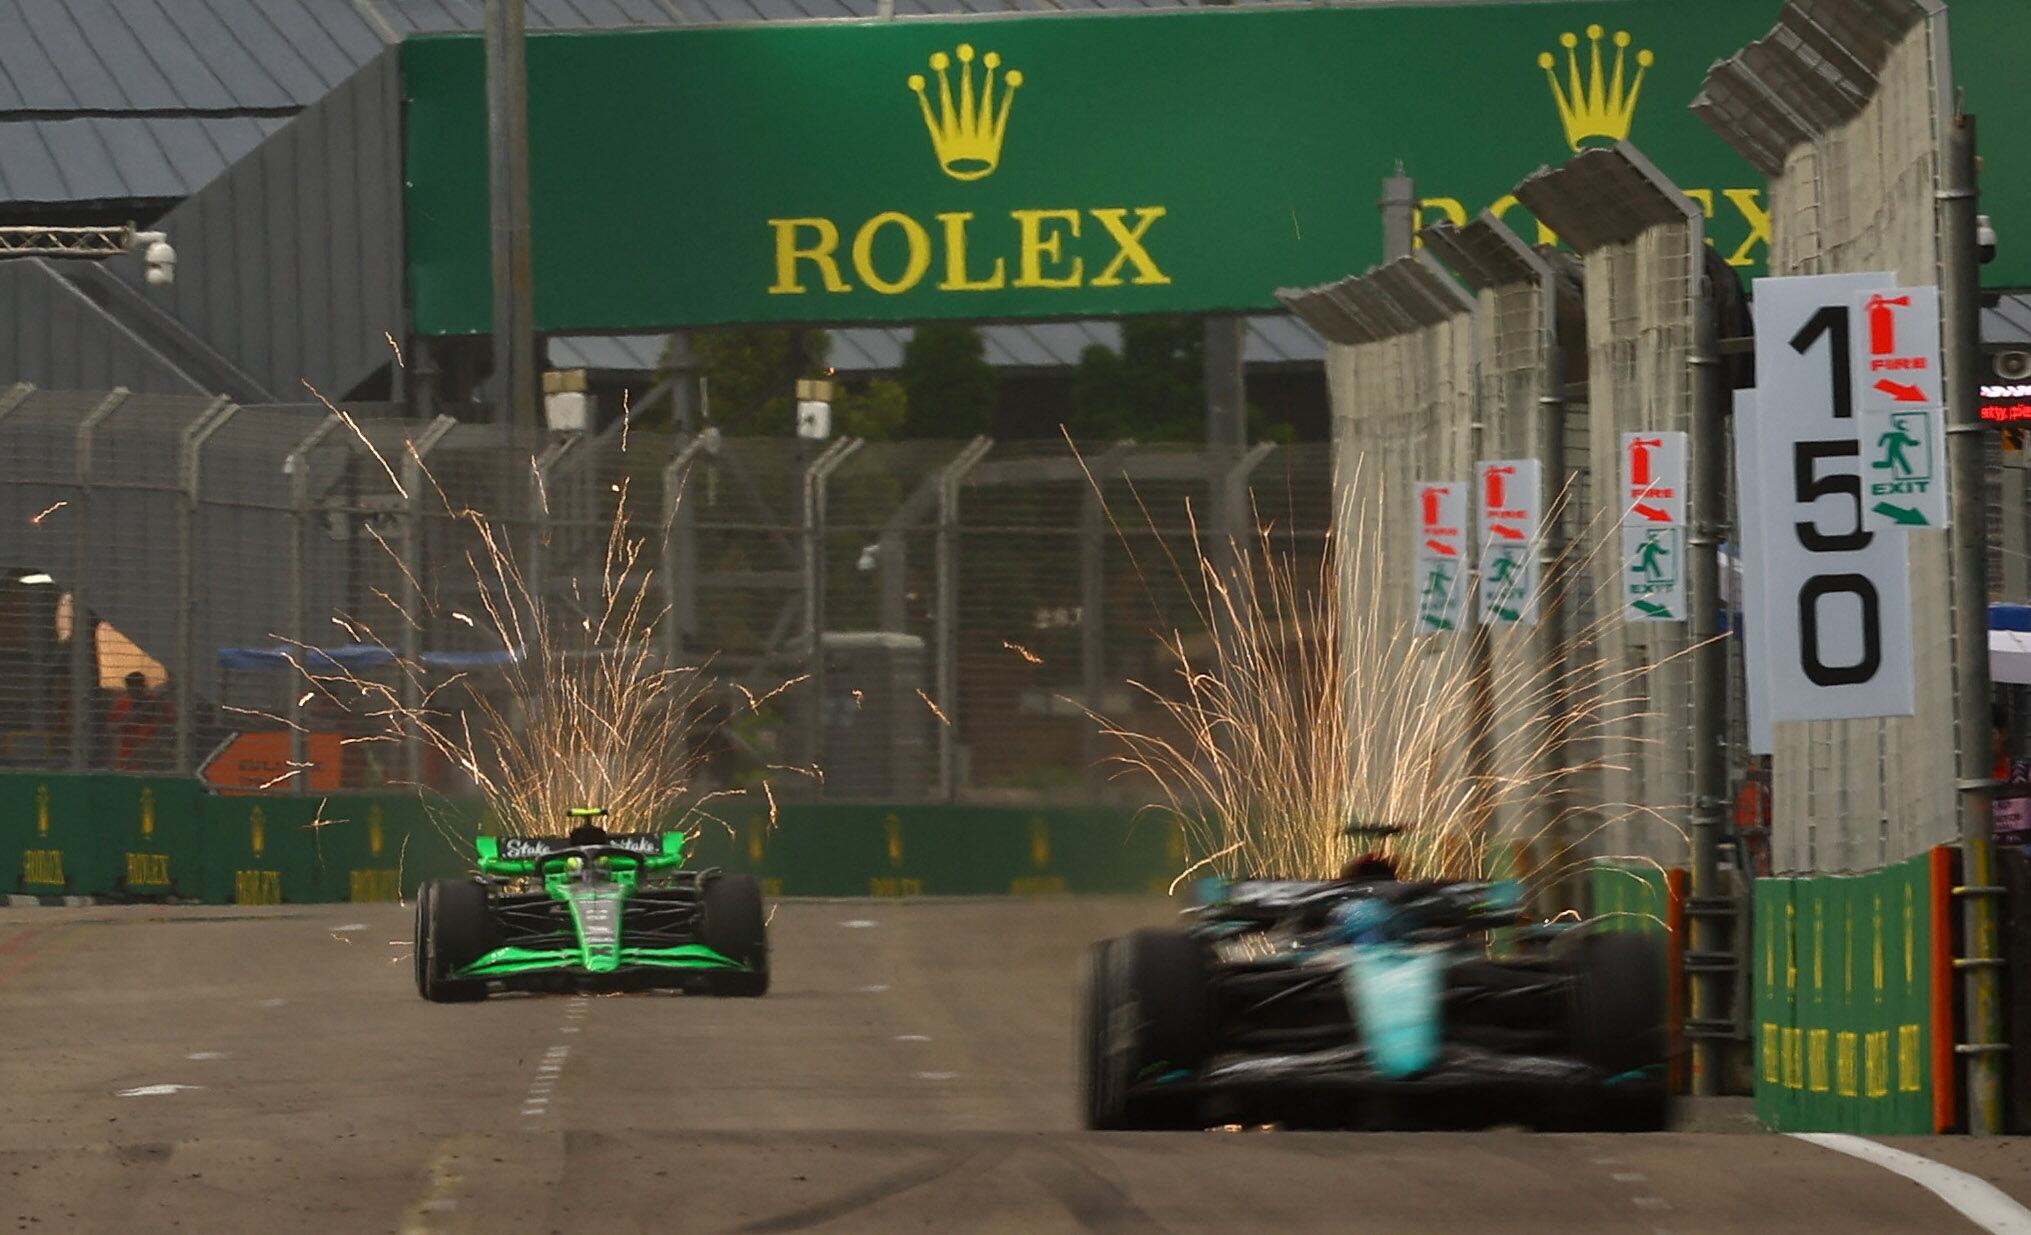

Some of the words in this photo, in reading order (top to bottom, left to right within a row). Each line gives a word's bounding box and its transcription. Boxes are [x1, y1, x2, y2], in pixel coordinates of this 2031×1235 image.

[768, 206, 1171, 295] ROLEX
[1871, 357, 1928, 371] FIRE
[1631, 488, 1675, 498] FIRE
[1788, 306, 1881, 686] 150
[1871, 481, 1929, 496] EXIT
[505, 839, 550, 859] Stake
